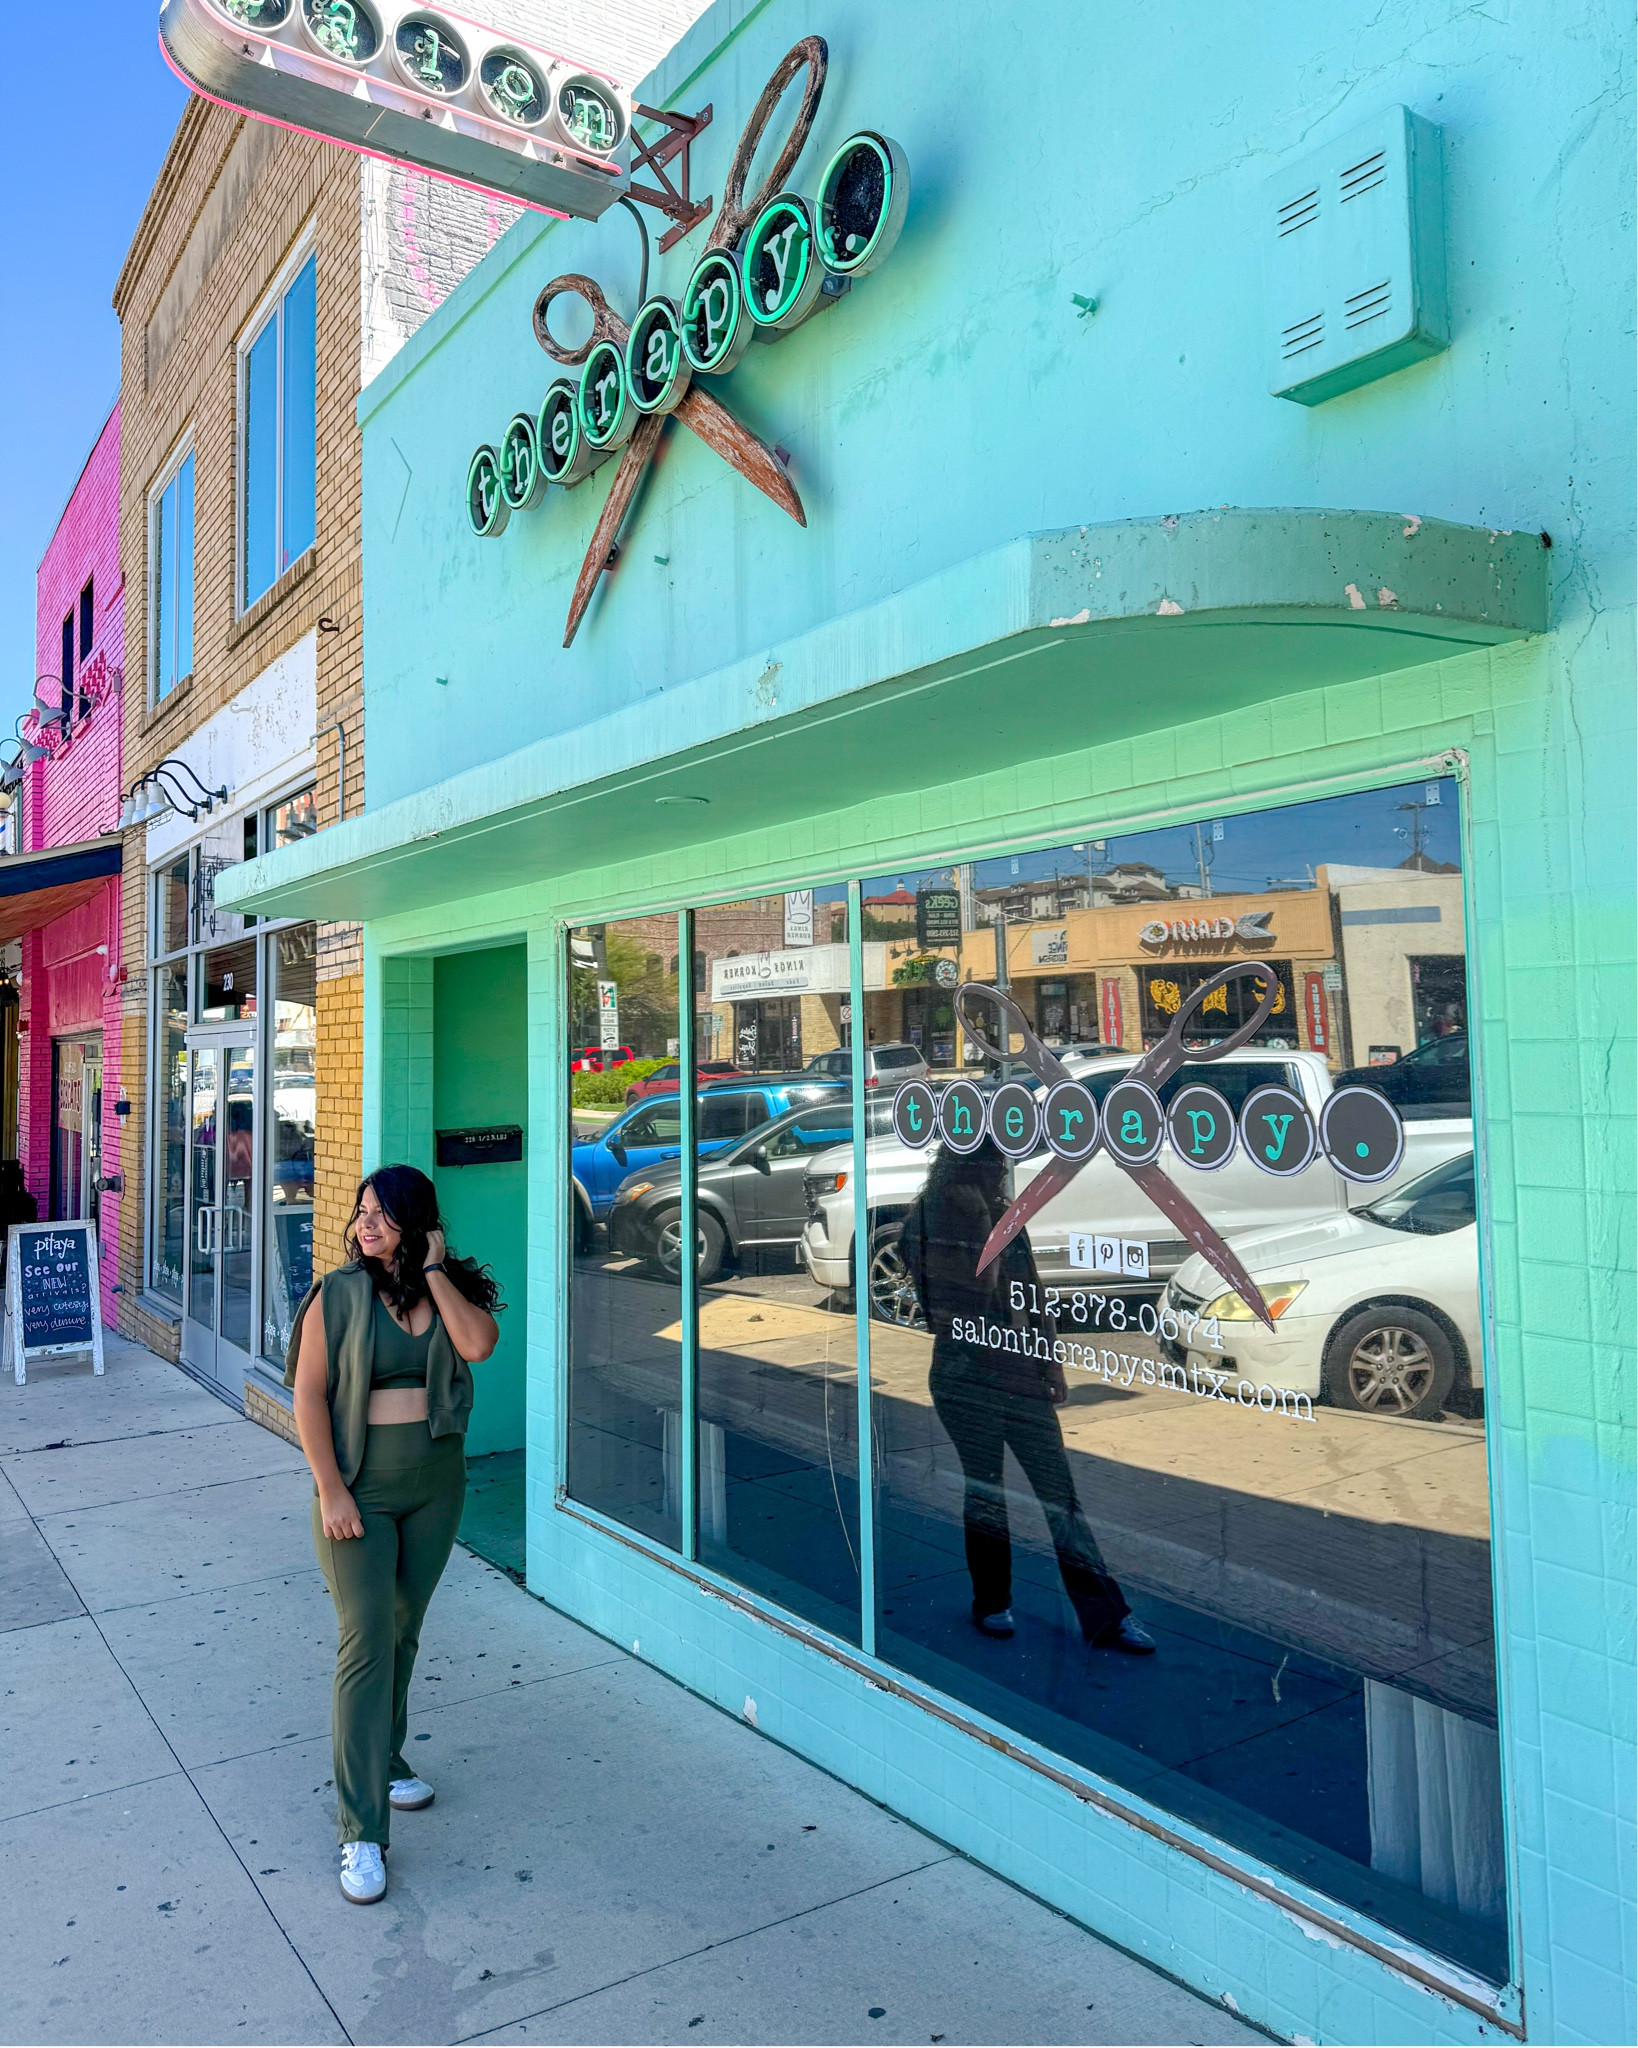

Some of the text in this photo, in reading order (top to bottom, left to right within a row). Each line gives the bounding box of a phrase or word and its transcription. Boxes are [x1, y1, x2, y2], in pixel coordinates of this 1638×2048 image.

[478, 220, 862, 516] therapy.
[222, 972, 234, 991] 230
[33, 1232, 76, 1260] pitaya
[42, 1275, 67, 1290] NEW
[24, 1304, 50, 1317] very
[1008, 1280, 1225, 1351] 512-878-0674
[25, 1320, 49, 1333] very
[951, 1315, 1318, 1423] salontherapysmtx.com
